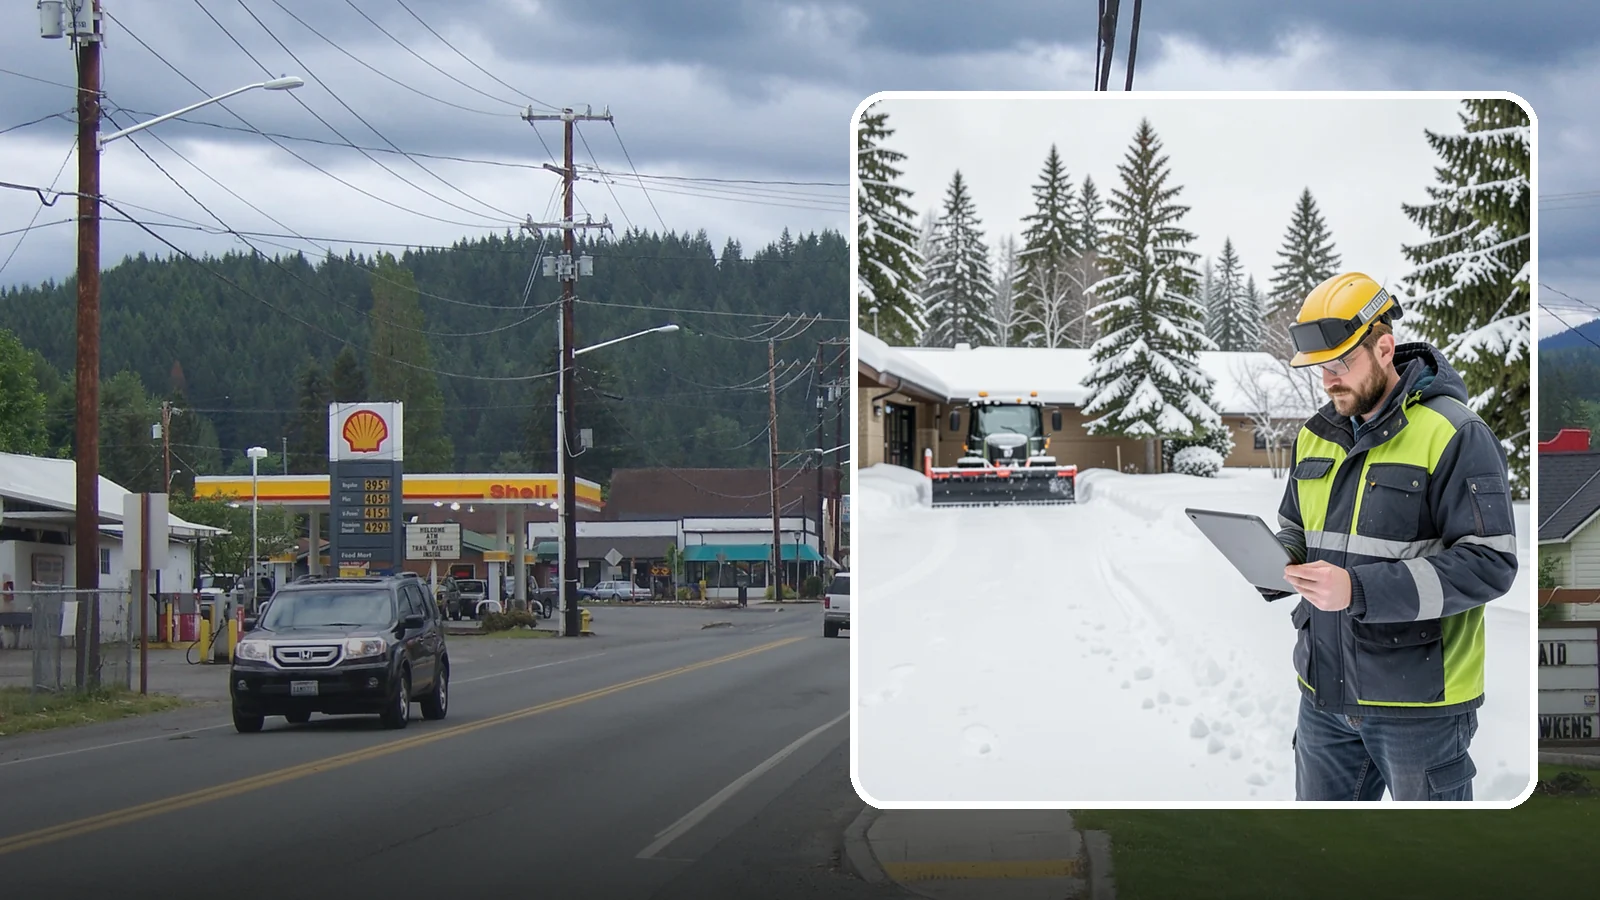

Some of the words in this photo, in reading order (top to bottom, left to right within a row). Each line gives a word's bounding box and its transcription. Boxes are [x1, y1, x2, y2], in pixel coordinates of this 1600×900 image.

[365, 480, 384, 490] 395
[490, 484, 547, 499] Shell
[365, 494, 384, 504] 405
[365, 508, 384, 518] 415
[365, 522, 384, 533] 429
